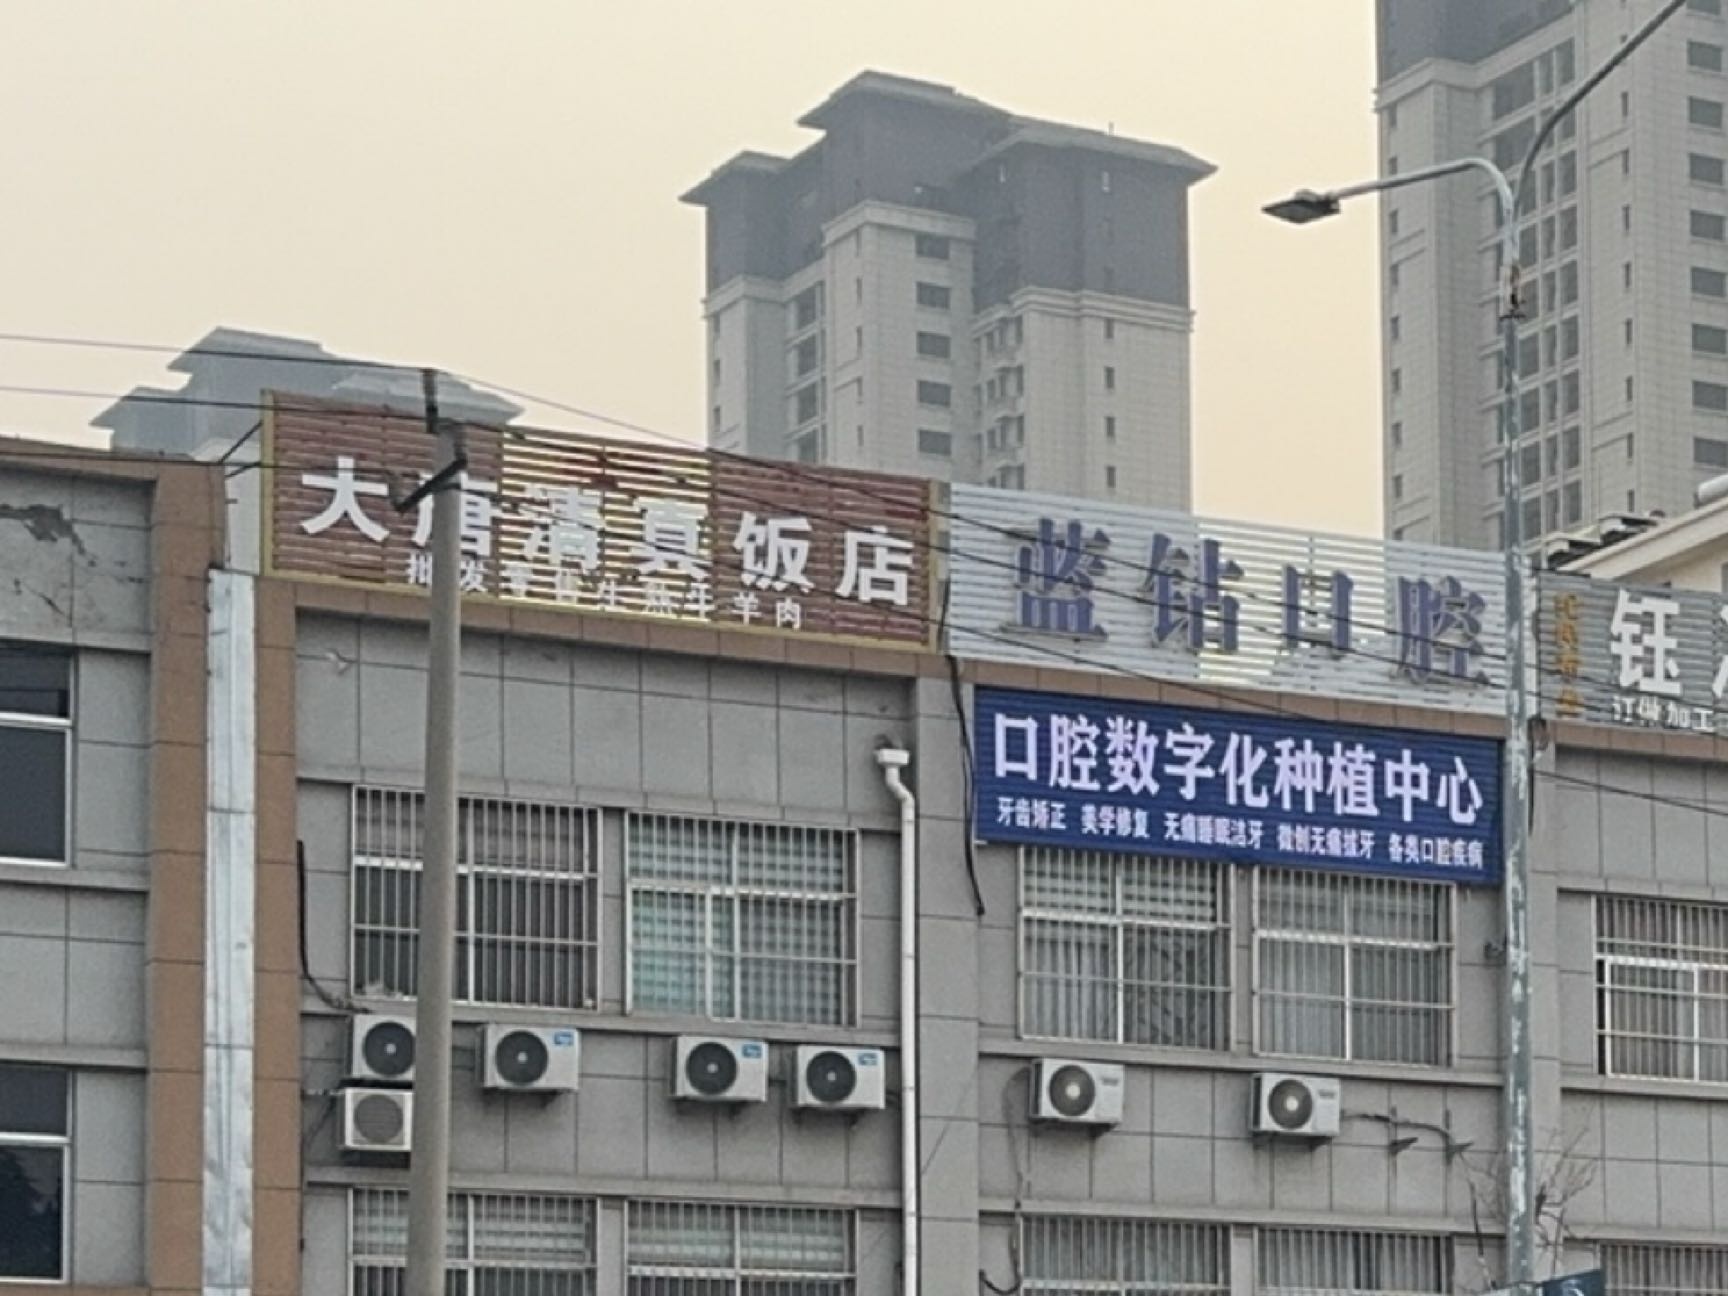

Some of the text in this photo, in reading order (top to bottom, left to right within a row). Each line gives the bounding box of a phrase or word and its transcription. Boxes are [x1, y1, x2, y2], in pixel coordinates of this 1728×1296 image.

[302, 455, 914, 605] 大唐清真饭店
[1000, 518, 1490, 687] 蓝钻口腔
[993, 713, 1484, 825] 口腔数字化种植中心
[1389, 833, 1484, 871] 各类口腔疾病
